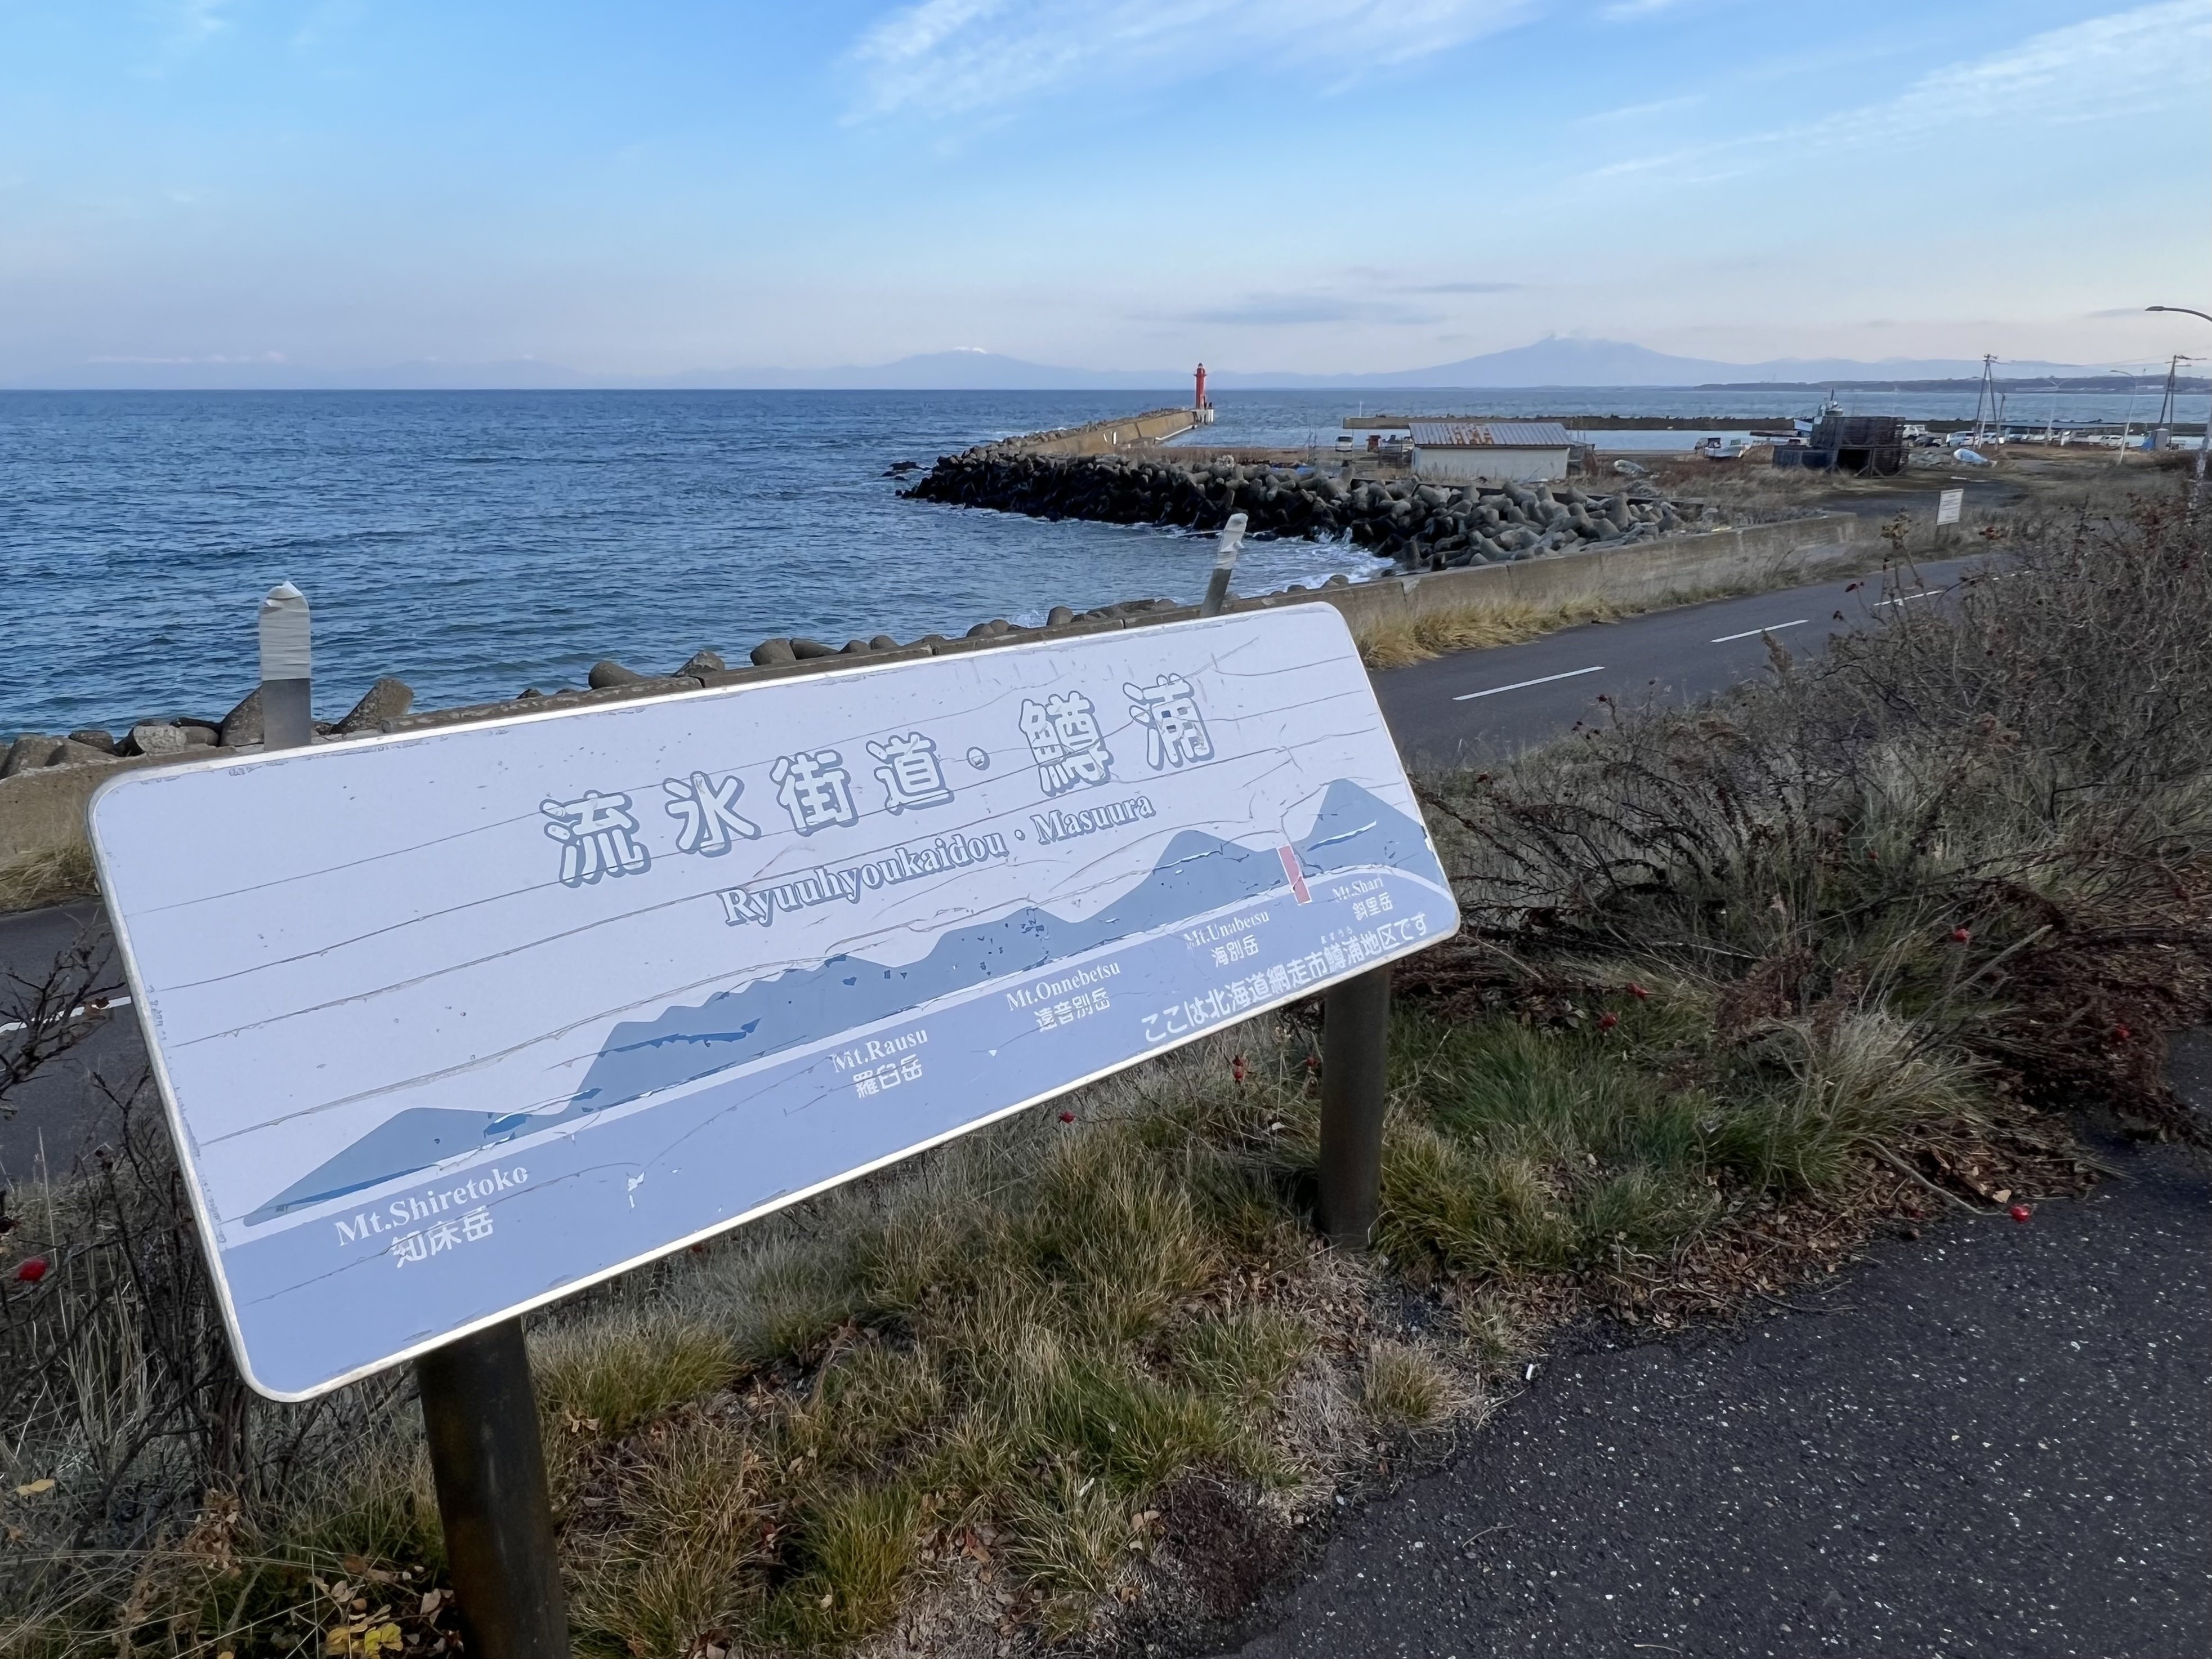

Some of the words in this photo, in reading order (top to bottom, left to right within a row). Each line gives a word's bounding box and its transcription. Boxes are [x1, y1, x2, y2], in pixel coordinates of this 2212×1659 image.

[539, 672, 1214, 888] 流氷街道・鱒浦
[717, 832, 1009, 927] Ryuuhyoukaidou
[1030, 793, 1156, 845] Masuura
[1210, 934, 1259, 968] 海別岳
[1006, 962, 1121, 1012] Mt.Onnebetsu
[1034, 987, 1111, 1033] 遠音別岳
[829, 1029, 928, 1073] Mt.Rausu
[852, 1054, 923, 1099] 羅臼岳
[334, 1166, 529, 1246] Mt.Shiretoko
[391, 1206, 494, 1268] 知床岳
